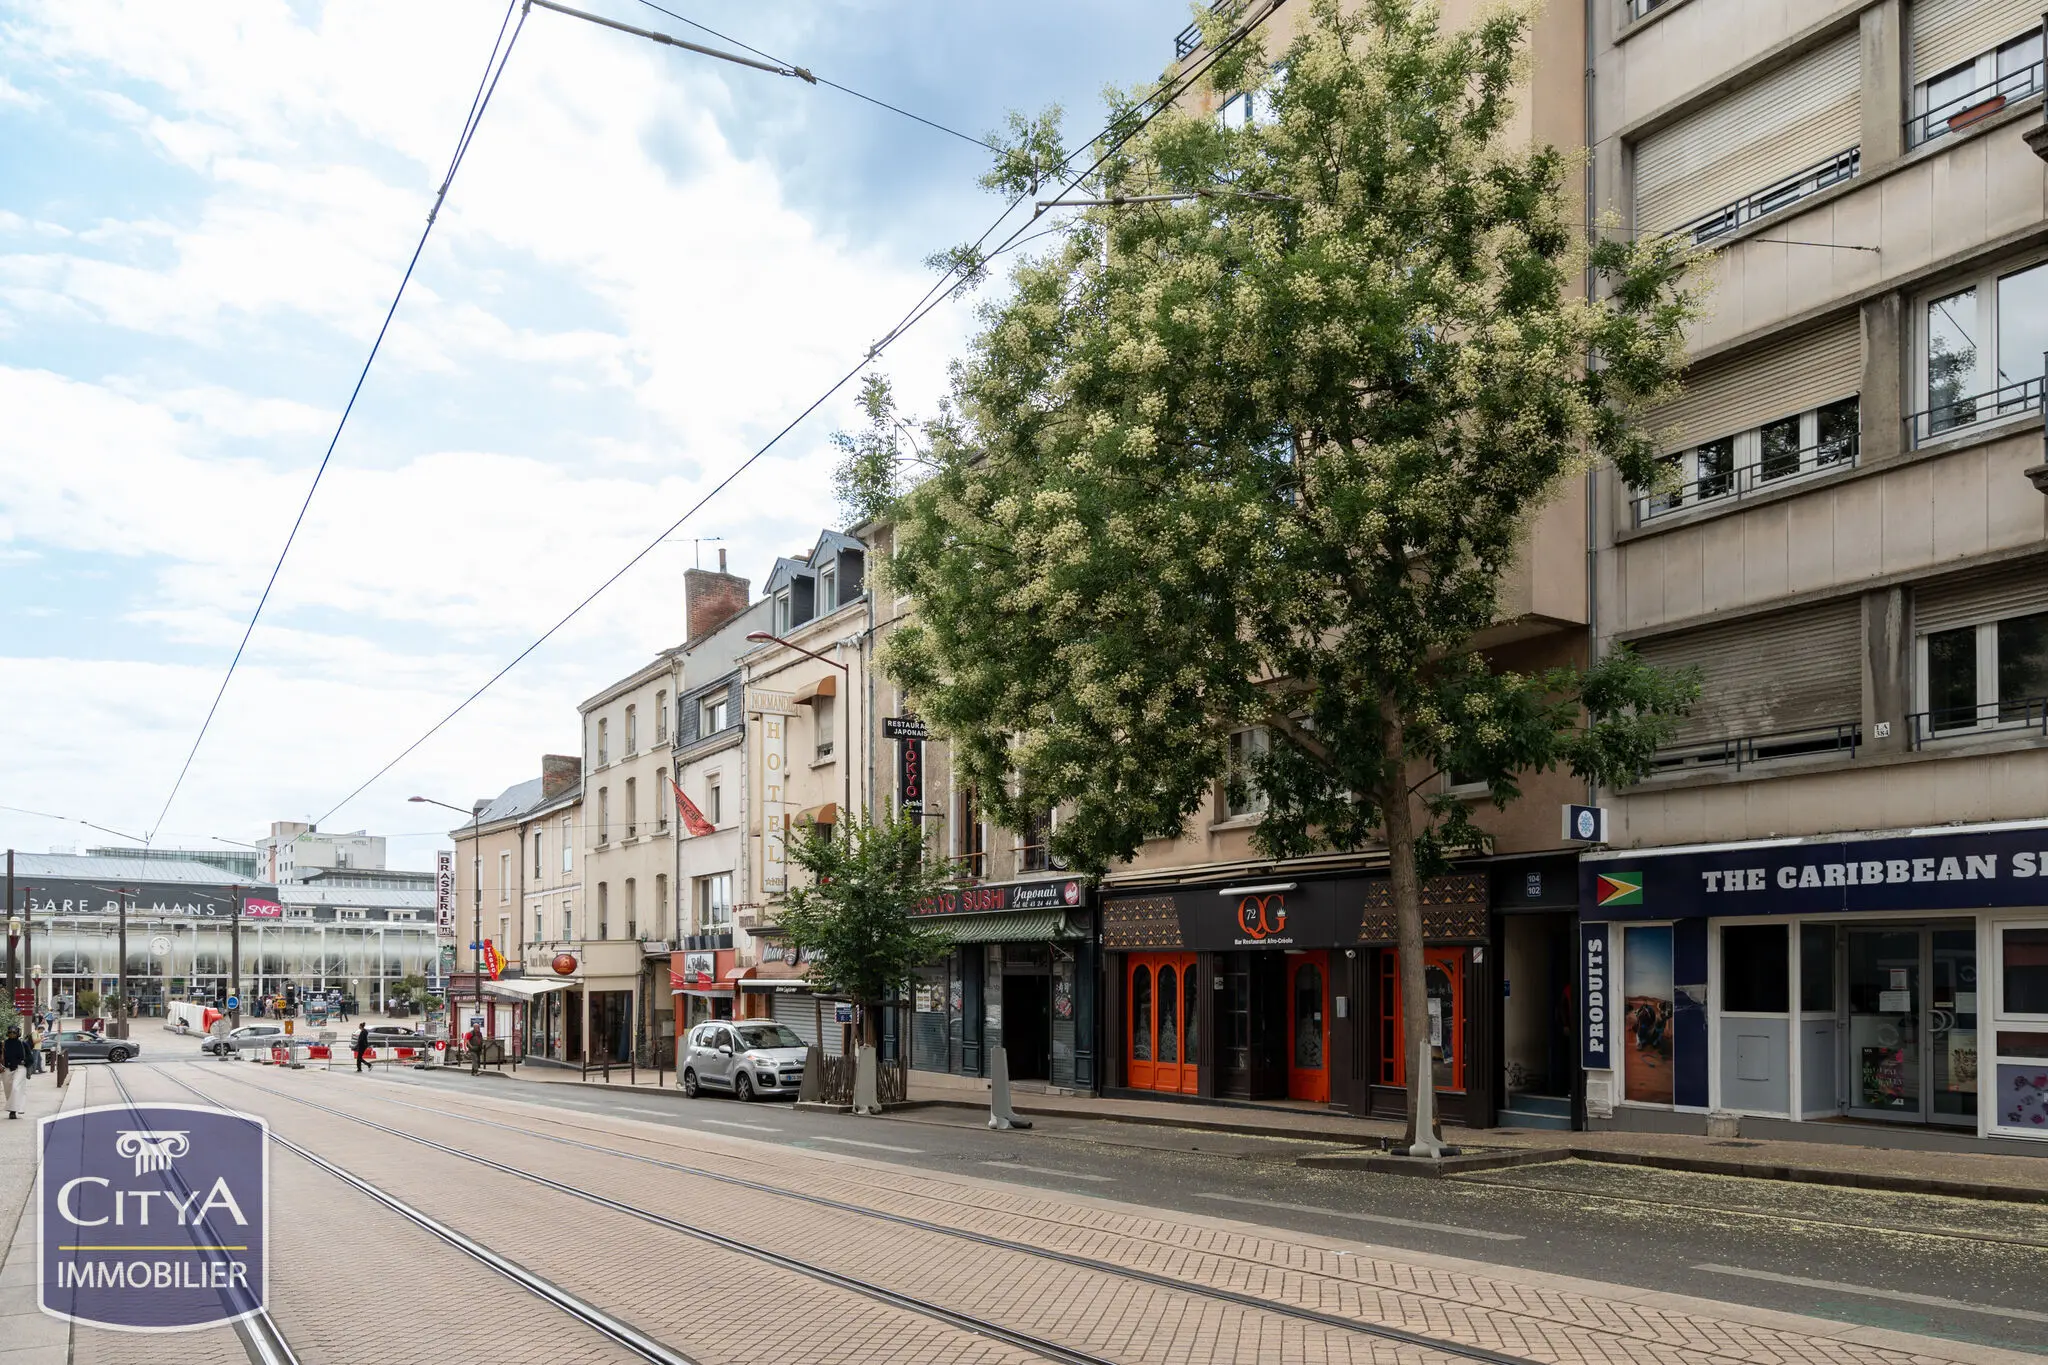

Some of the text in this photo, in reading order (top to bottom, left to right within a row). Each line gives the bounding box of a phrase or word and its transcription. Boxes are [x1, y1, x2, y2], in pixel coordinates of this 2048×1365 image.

[887, 720, 926, 730] RESTAURA
[894, 728, 928, 737] JAPONAIS
[906, 738, 918, 797] TOKYO
[767, 722, 781, 862] HOTEL
[1527, 875, 1540, 883] 104
[1702, 868, 1766, 892] THE
[1777, 854, 1998, 889] CARIBBEAN
[440, 856, 450, 926] BRASSERIE
[963, 888, 1005, 911] SUSHI
[1013, 885, 1057, 901] Japonais
[1527, 887, 1540, 895] 102
[24, 899, 216, 916] GARE DU MANS
[246, 904, 281, 915] SNCF
[1238, 894, 1287, 939] QG
[1246, 909, 1257, 920] 72
[1588, 938, 1604, 1053] PRODUITS
